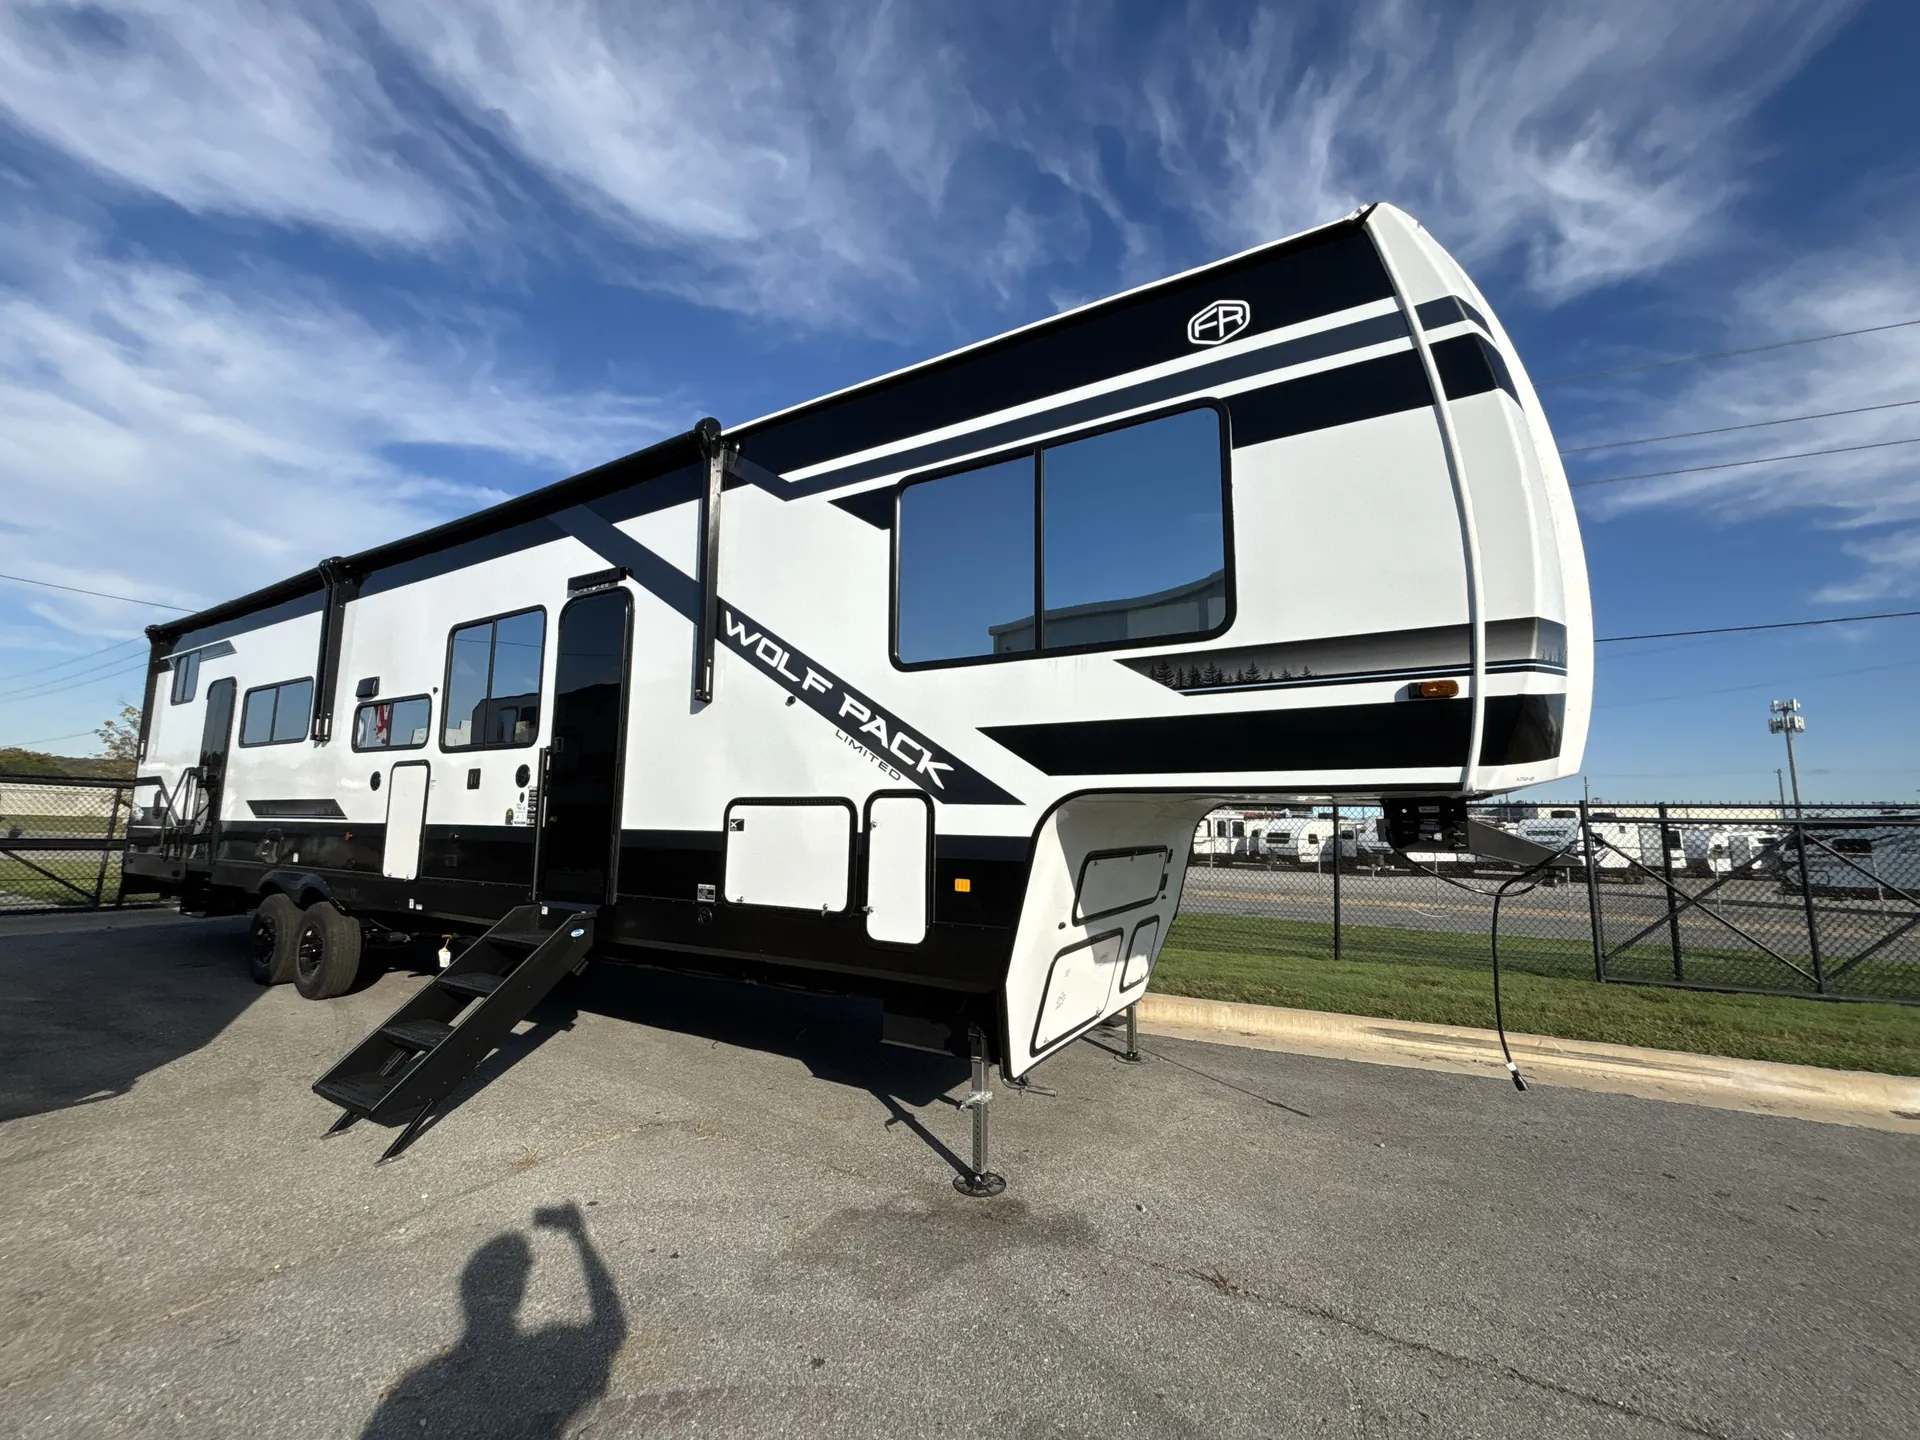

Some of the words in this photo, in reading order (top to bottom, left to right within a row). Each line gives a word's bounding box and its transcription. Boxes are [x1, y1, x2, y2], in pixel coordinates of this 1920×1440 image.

[1193, 305, 1244, 338] FR
[725, 610, 833, 694] WOLF
[838, 692, 955, 790] PACK
[835, 729, 901, 781] LIMITED
